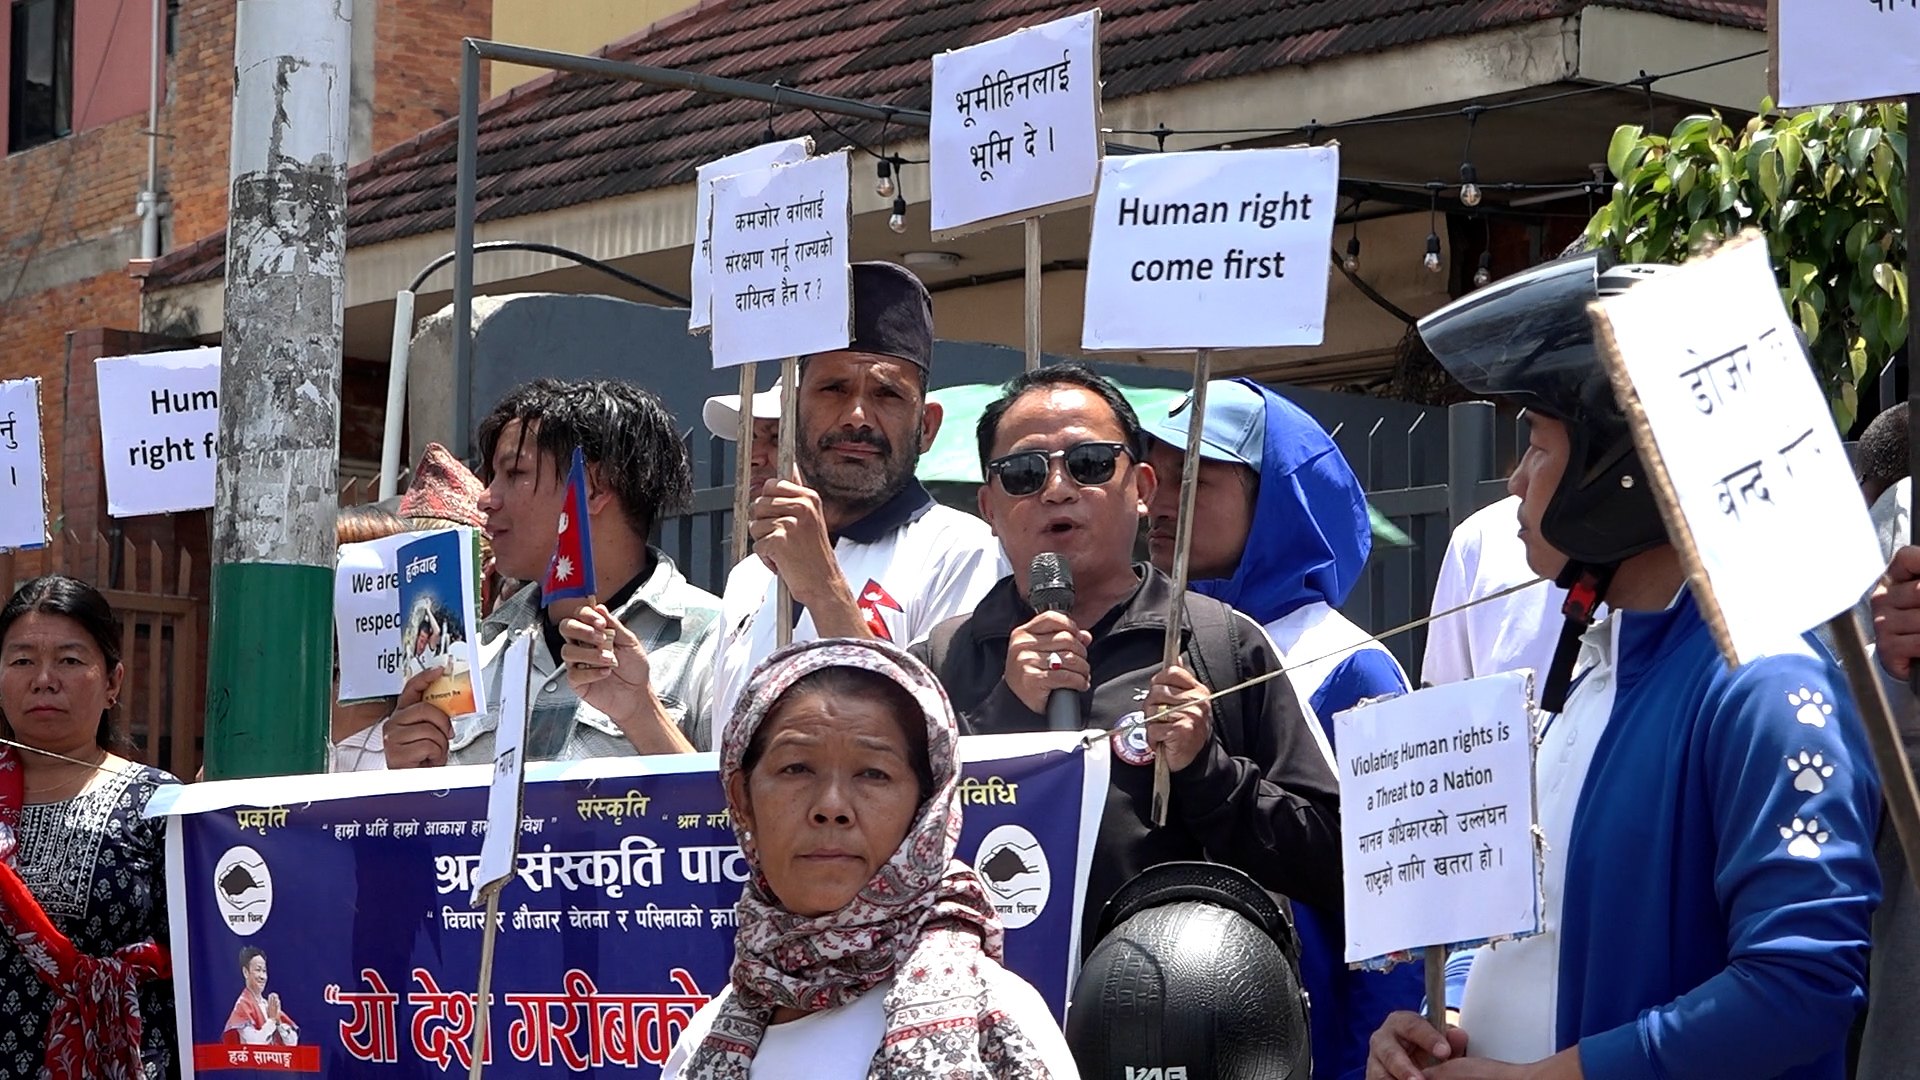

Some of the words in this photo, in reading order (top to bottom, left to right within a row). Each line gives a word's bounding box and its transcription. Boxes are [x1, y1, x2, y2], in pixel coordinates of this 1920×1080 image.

[970, 130, 1014, 181] भूमि
[1024, 122, 1037, 157] दे
[735, 202, 780, 232] कमजोर
[1118, 197, 1228, 226] Human
[1238, 191, 1312, 229] right
[795, 231, 833, 262] राज्यको
[1131, 258, 1213, 282] come
[1224, 249, 1285, 280] first
[735, 284, 776, 312] दायित्व
[782, 277, 798, 306] हैन
[804, 281, 811, 301] र
[151, 389, 218, 415] Hum
[129, 437, 195, 470] right
[203, 432, 218, 459] f
[352, 572, 373, 594] We
[377, 572, 399, 590] are
[355, 613, 400, 635] respec
[378, 647, 402, 674] righ
[1351, 750, 1399, 777] Violating
[1400, 738, 1448, 762] Human
[1453, 726, 1493, 753] rights
[1497, 721, 1510, 742] is
[957, 776, 1018, 806] विधि
[1367, 795, 1373, 810] a
[1376, 782, 1407, 809] Threat
[1410, 778, 1424, 797] to
[1430, 779, 1438, 794] a
[1444, 766, 1493, 792] Nation
[577, 789, 650, 825] संस्कृति
[677, 814, 701, 829] श्रम
[334, 820, 361, 840] हाम्रो
[393, 818, 420, 839] हाम्रो
[424, 820, 467, 837] आकाश
[1359, 831, 1382, 854] मानव
[1388, 809, 1448, 844] अधिकारको
[1456, 803, 1507, 833] उल्लंघन
[516, 835, 665, 898] संस्कृति
[678, 845, 751, 884] पाट
[1364, 865, 1393, 896] राष्ट्रको
[1398, 854, 1426, 883] लागि
[1434, 853, 1473, 876] खतरा
[1480, 843, 1493, 870] हो
[512, 903, 561, 933] औजार
[567, 905, 609, 930] चेतना
[617, 909, 628, 932] र
[635, 903, 703, 930] पसिनाको
[709, 902, 739, 930] क्रा
